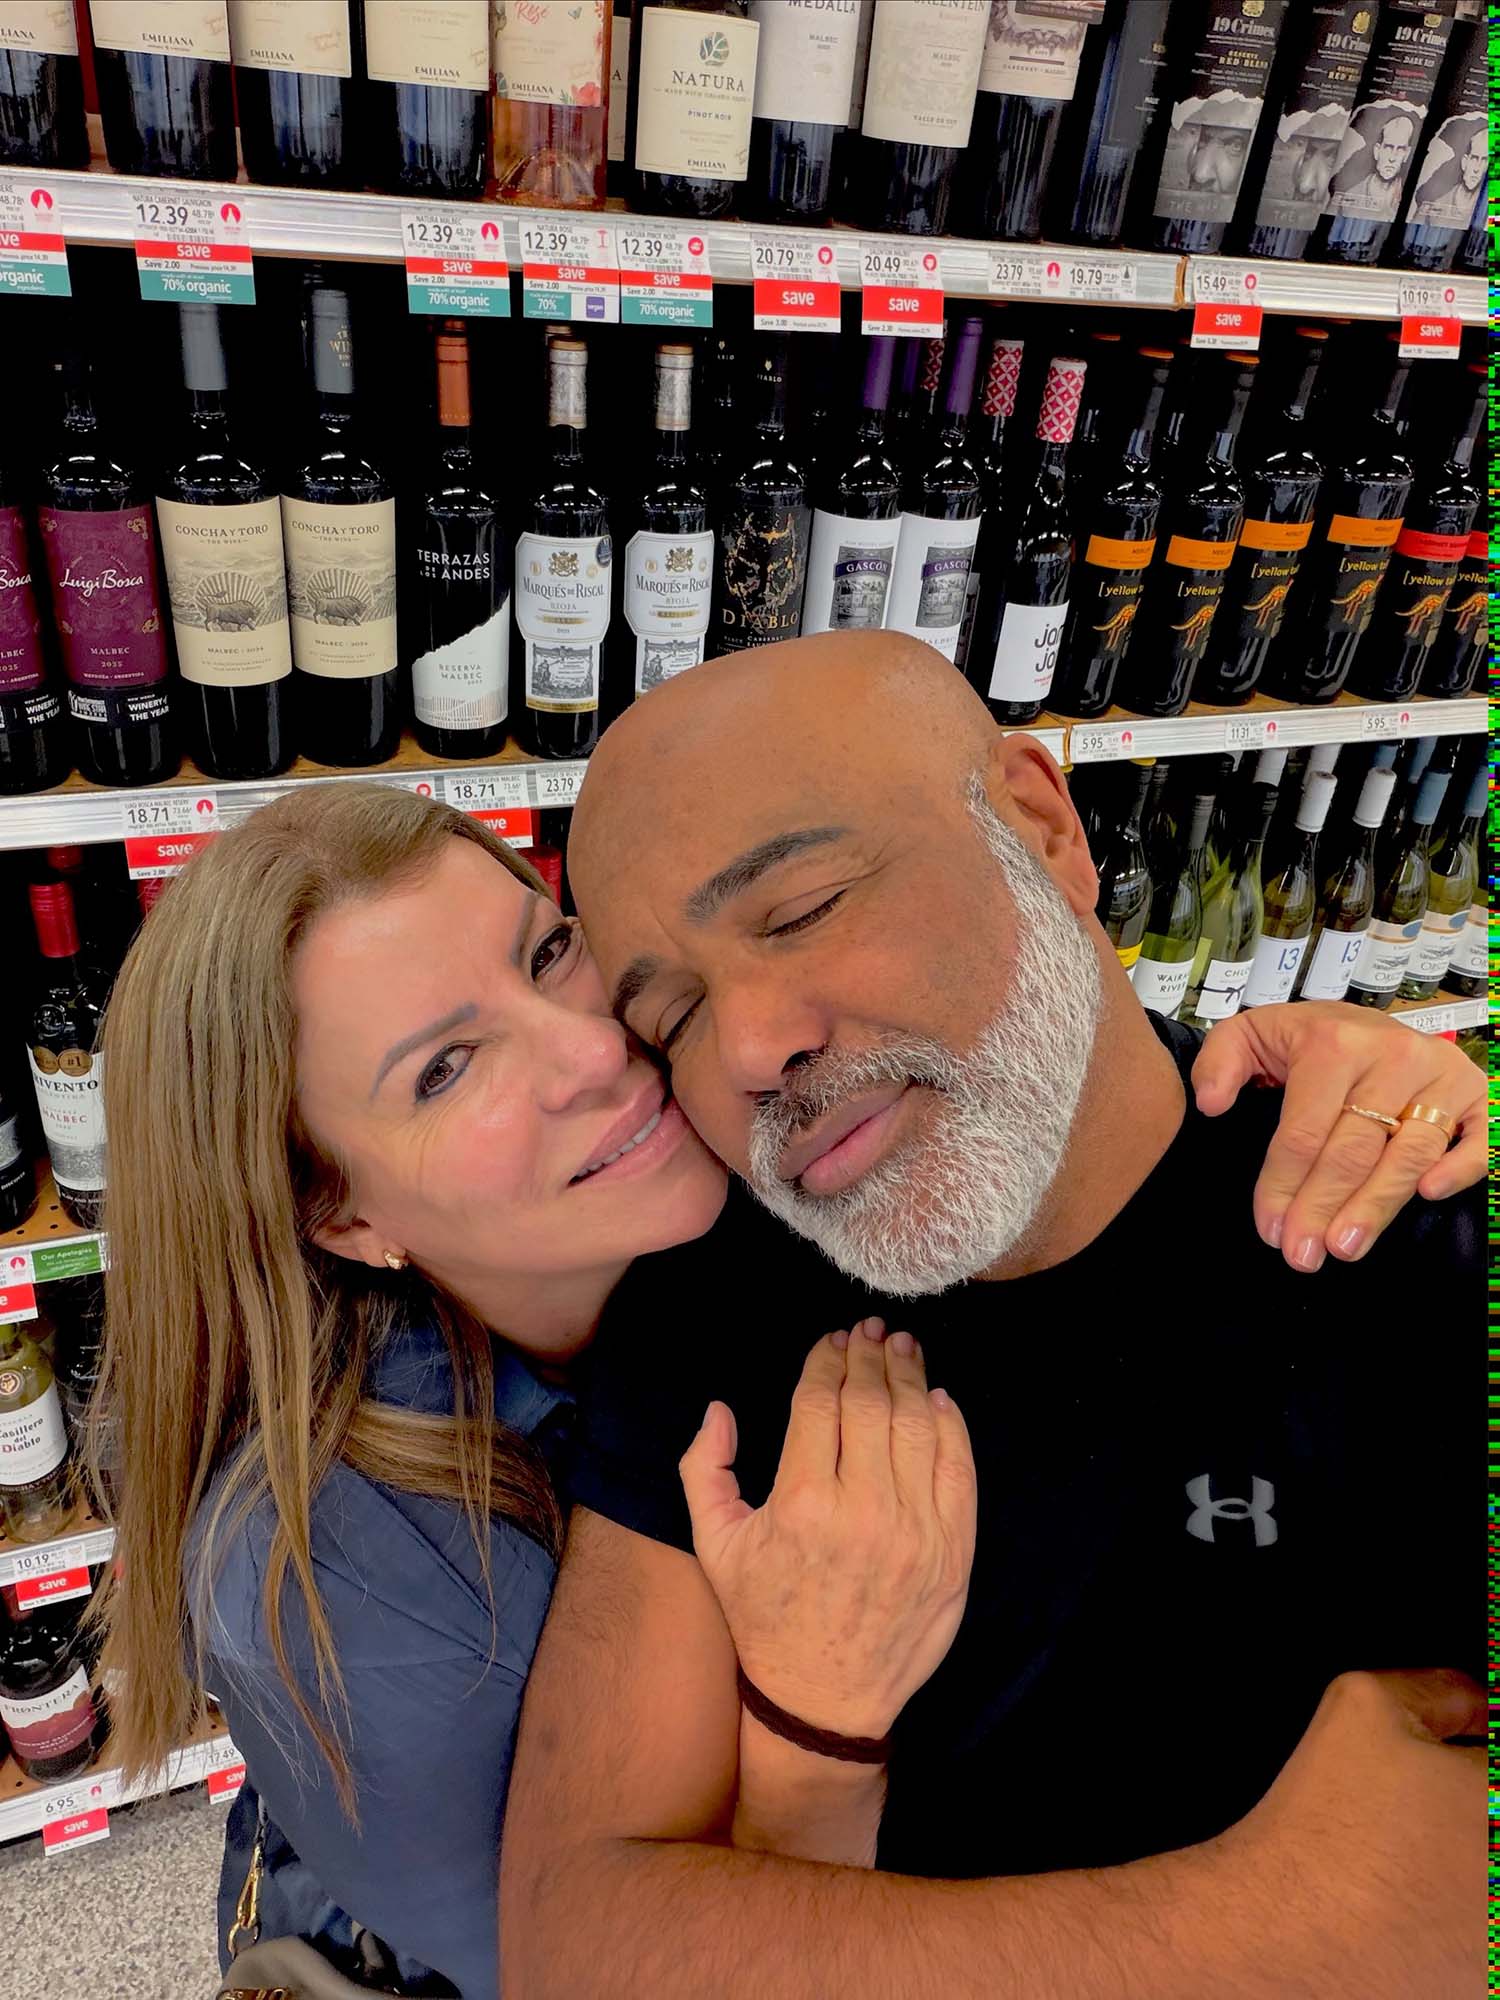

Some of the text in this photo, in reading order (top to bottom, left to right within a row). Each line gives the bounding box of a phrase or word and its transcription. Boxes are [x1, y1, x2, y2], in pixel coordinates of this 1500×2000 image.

[142, 33, 194, 47] EMILIANA
[250, 49, 294, 62] EMILIANA
[415, 66, 460, 78] EMILIANA
[512, 83, 554, 94] EMILIANA
[672, 70, 744, 92] NATURA
[136, 204, 189, 226] 12.39
[408, 223, 452, 243] 12.39
[525, 232, 567, 251] 12.39
[622, 238, 663, 257] 12.39
[176, 244, 211, 258] save
[756, 248, 794, 266] 20.79
[144, 260, 180, 269] Save 2.00
[442, 261, 473, 273] save
[865, 256, 900, 273] 20.49
[996, 264, 1023, 280] 2379
[414, 275, 445, 284] Save 2.00
[558, 268, 586, 280] save
[653, 274, 681, 286] save
[1070, 268, 1102, 285] 19.79
[162, 278, 232, 296] 70% organic
[529, 281, 559, 290] Save 2.00
[626, 287, 640, 295] Save
[1197, 276, 1226, 291] 1549
[428, 293, 490, 310] 70% organic
[537, 298, 556, 310] 70%
[782, 290, 815, 306] save
[889, 297, 919, 312] save
[1403, 290, 1429, 304] 1019
[639, 304, 694, 319] 70% organic
[761, 318, 774, 326] Save
[1215, 313, 1242, 327] save
[1420, 325, 1444, 338] save
[175, 525, 228, 537] CONCHA
[238, 524, 269, 536] TORO
[291, 520, 338, 535] CONCHA
[349, 524, 380, 535] TORO
[417, 549, 490, 566] TERRAZAS
[441, 567, 490, 580] ANDES
[846, 560, 888, 573] GASCÓN
[59, 568, 144, 597] Luigi Bosca
[522, 577, 567, 600] MARQUÉS
[576, 582, 605, 598] RISCAL
[635, 575, 681, 594] MARQUÉS
[550, 603, 577, 611] RIOJA
[722, 609, 797, 629] DIABLO
[90, 647, 130, 655] MALBEC
[439, 664, 481, 672] RESERVA
[441, 671, 483, 680] MALBEC
[25, 698, 55, 715] WINERY
[128, 699, 162, 712] WINERY
[27, 713, 45, 725] THE
[130, 705, 169, 722] THE YEAR
[1367, 718, 1385, 728] 595
[1231, 728, 1249, 739] 1131
[1082, 737, 1103, 750] 595
[454, 783, 495, 799] 18.71
[546, 777, 573, 792] 2379
[128, 807, 169, 824] 18.71
[157, 843, 193, 857] save
[1277, 947, 1300, 971] 13
[1341, 940, 1362, 964] 13
[57, 1247, 92, 1259] Apologies
[0, 1418, 43, 1438] asillero
[2, 1436, 41, 1453] Diablo
[14, 1435, 27, 1443] del
[17, 1554, 49, 1569] 1019
[39, 1577, 67, 1591] save
[209, 1749, 235, 1764] 1749
[46, 1797, 74, 1813] 695
[64, 1819, 89, 1834] save
